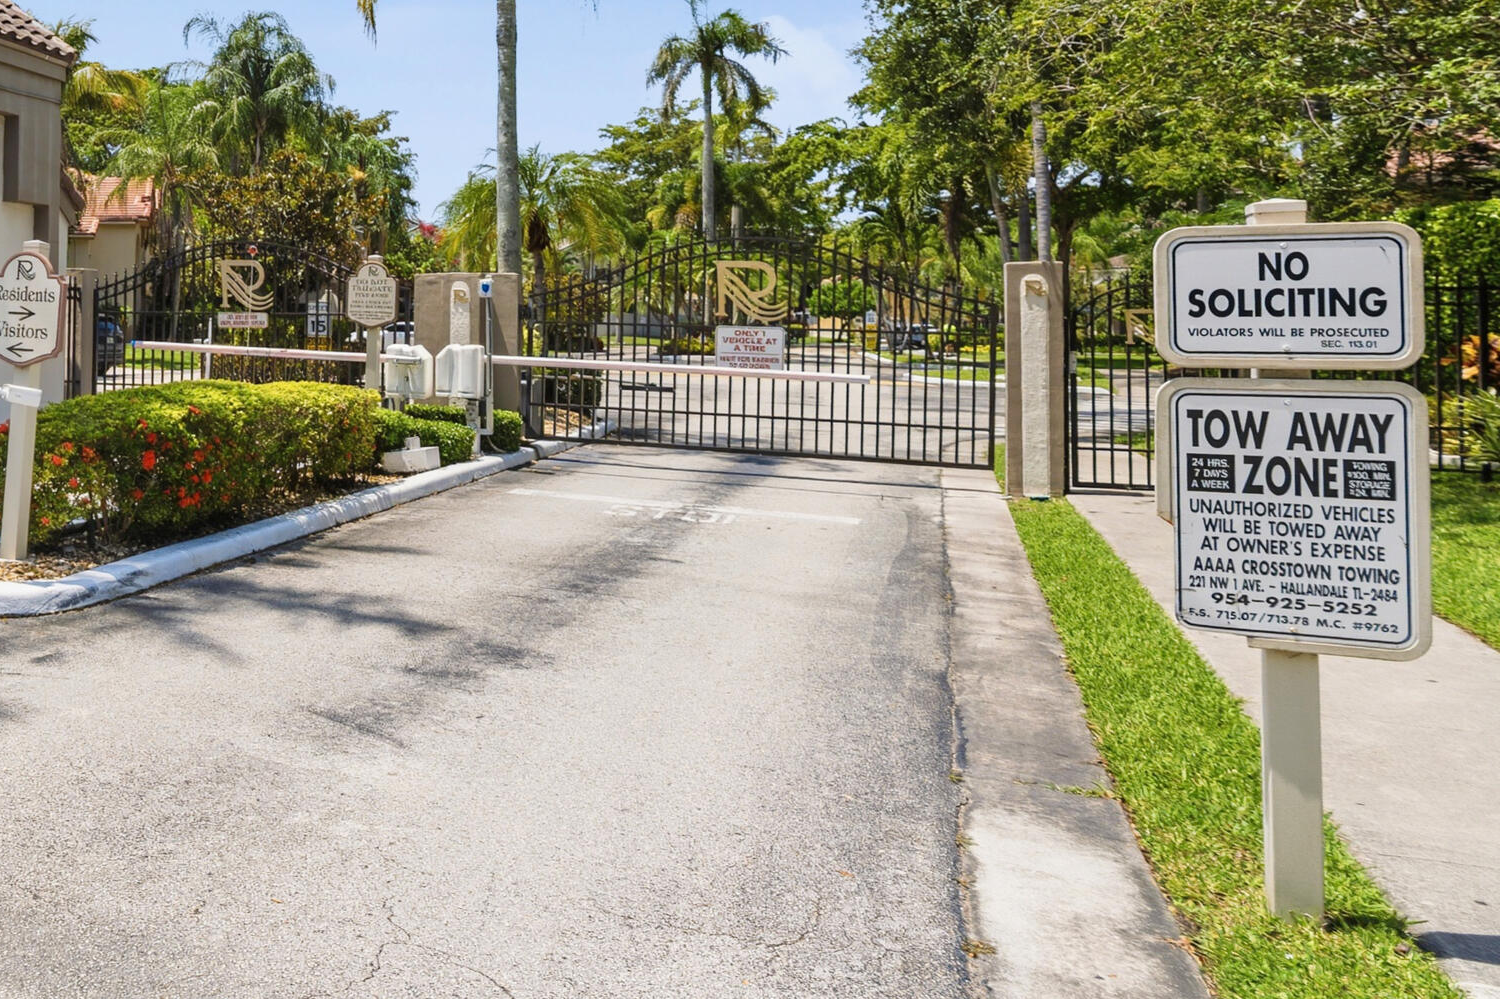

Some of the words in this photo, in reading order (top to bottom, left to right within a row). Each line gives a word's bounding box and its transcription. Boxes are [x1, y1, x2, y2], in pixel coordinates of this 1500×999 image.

[1258, 251, 1309, 281] NO
[1188, 286, 1388, 318] SOLICITING
[311, 320, 326, 333] 15
[734, 329, 759, 337] ONLY
[1188, 327, 1253, 338] VIOLATORS
[1259, 327, 1286, 338] WILL
[1290, 327, 1305, 338] BE
[1310, 327, 1389, 338] PROSECUTED
[722, 336, 762, 344] VEHICLE
[743, 344, 766, 352] TIME
[1187, 409, 1269, 449] TOW
[1287, 411, 1395, 454] AWAY
[1191, 457, 1204, 467] 24
[1207, 458, 1230, 468] HRS.
[1193, 468, 1200, 477] 7
[1203, 468, 1229, 478] DAYS
[1191, 479, 1199, 488] A
[1201, 479, 1230, 489] WEEK
[1242, 455, 1339, 498] ZONE
[1190, 498, 1313, 519] UNAUTHORIZED
[1321, 505, 1395, 524] VEHICLES
[1202, 517, 1237, 534] WILL
[1243, 520, 1261, 535] BE
[1269, 520, 1326, 539] TOWED
[1334, 525, 1382, 542] AWAY
[1200, 536, 1219, 551] AT
[1226, 537, 1303, 556] OWNER'S
[1311, 542, 1386, 562] EXPENSE
[1193, 556, 1236, 574] AAAA
[1242, 559, 1331, 581] CROSSTOWN
[1338, 566, 1400, 585] TOWING
[1189, 574, 1206, 588] 221
[1209, 576, 1229, 589] NW
[1233, 577, 1238, 590] 1
[1242, 578, 1265, 592] AVE.
[1281, 581, 1348, 599] HALLANDALE
[1211, 592, 1378, 617] 954-925-5252
[1188, 607, 1210, 618] F.S.
[1316, 618, 1346, 629] M.C.
[1352, 621, 1399, 634] #9762
